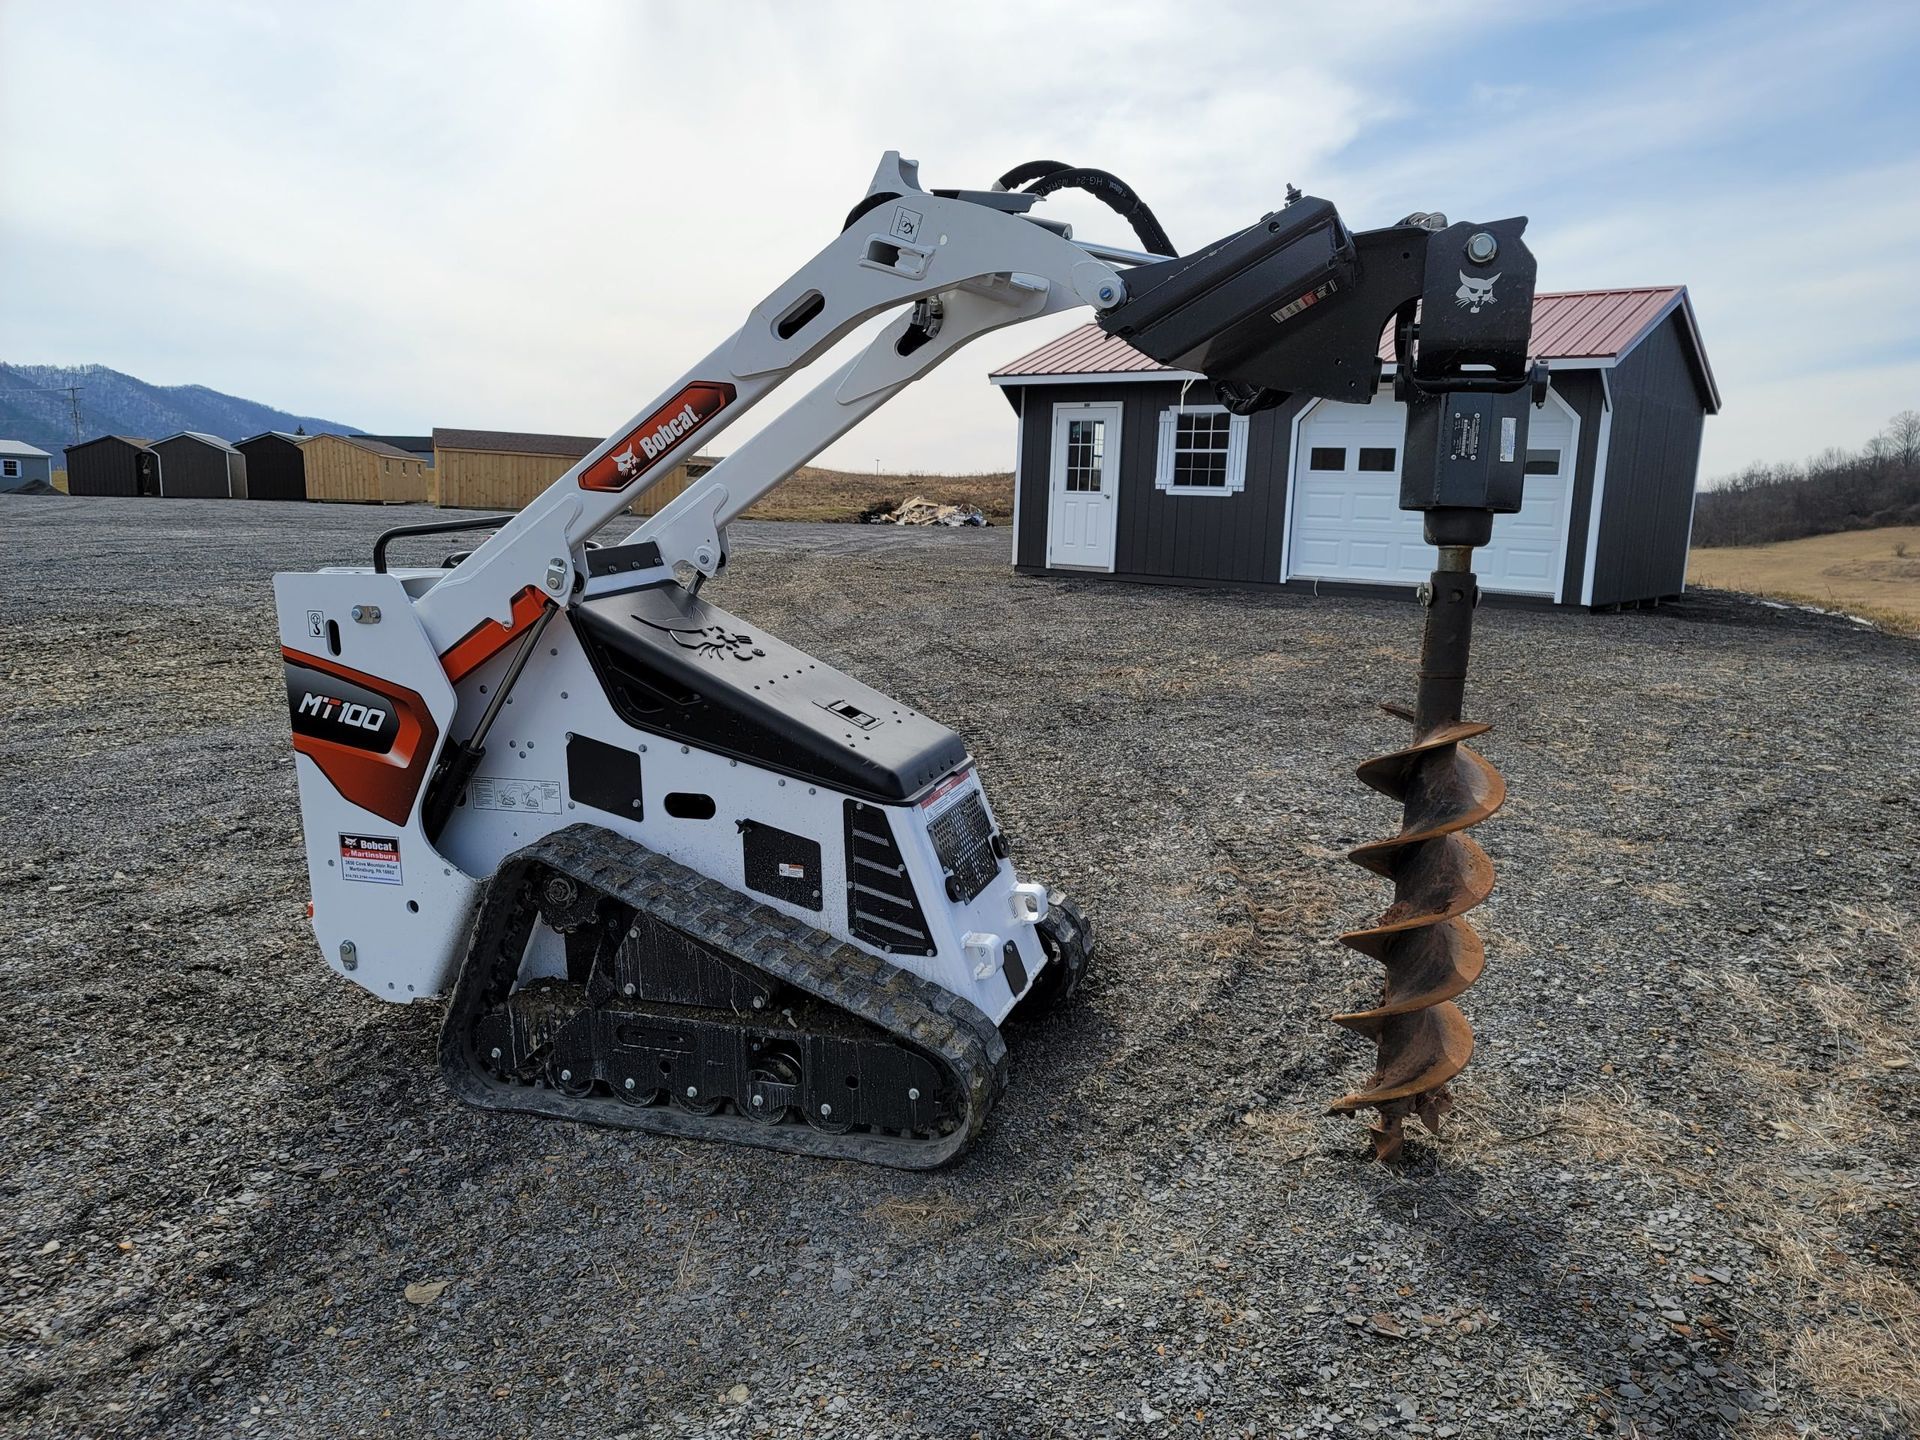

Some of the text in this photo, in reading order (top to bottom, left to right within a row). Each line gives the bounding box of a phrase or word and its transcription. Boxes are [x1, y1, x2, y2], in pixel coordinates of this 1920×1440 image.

[1076, 176, 1103, 186] HG-24
[639, 404, 699, 459] Bobcat
[298, 692, 386, 732] MT100
[360, 840, 392, 851] Bobcat
[350, 850, 397, 861] Martinsburg
